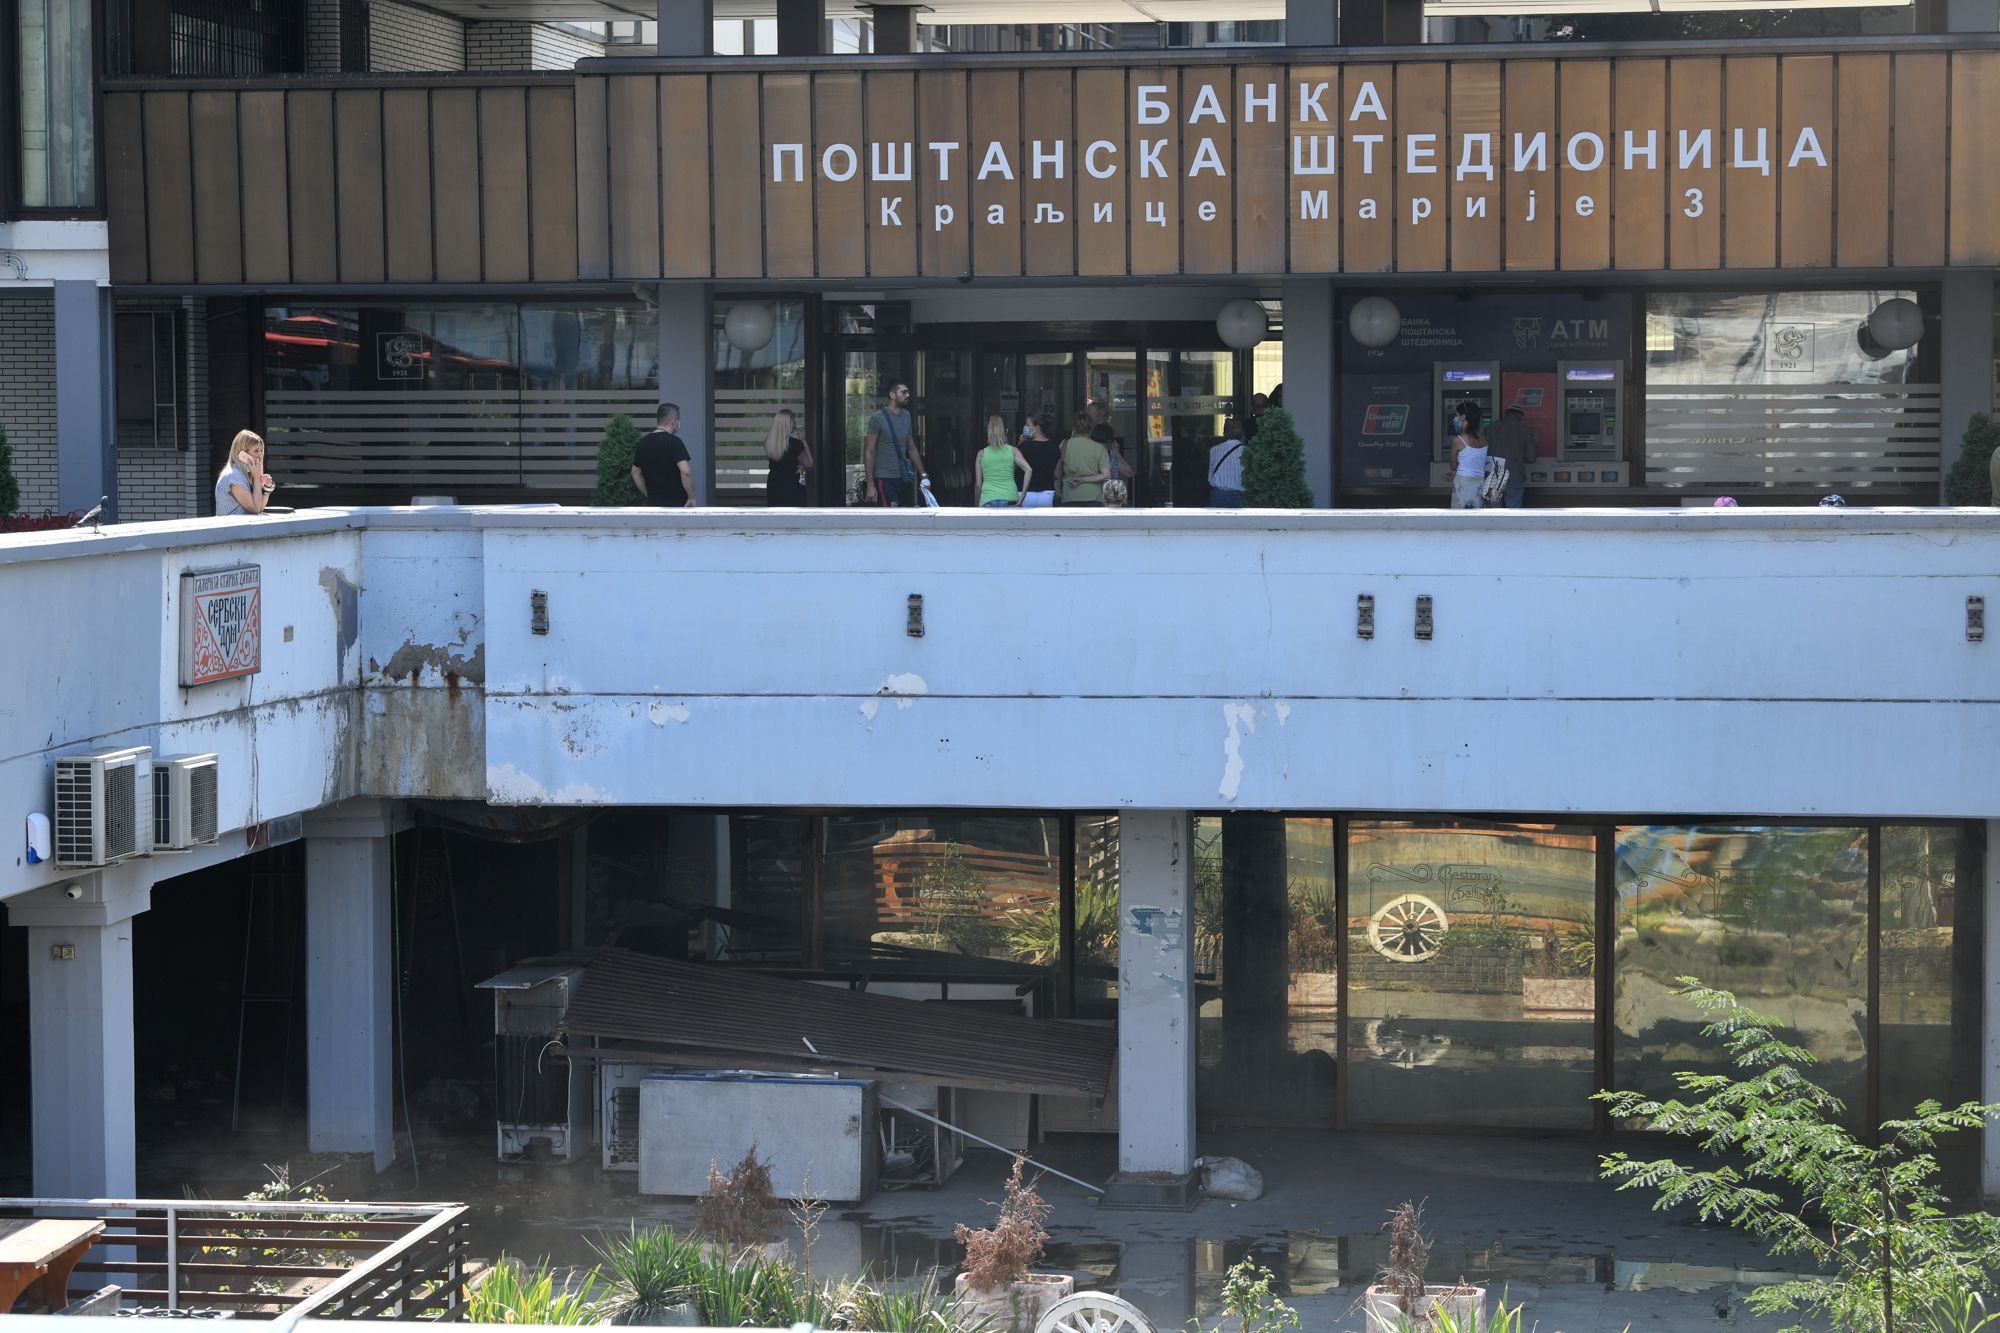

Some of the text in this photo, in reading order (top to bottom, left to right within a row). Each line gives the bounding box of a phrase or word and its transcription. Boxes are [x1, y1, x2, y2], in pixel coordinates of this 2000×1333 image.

[1138, 82, 1387, 124] БАНКА
[773, 127, 1828, 183] ПОШТАНСКА ШТЕДИОНИЦА
[881, 188, 1704, 231] Краљице Марије 3
[1401, 318, 1431, 326] БАНКА
[1401, 328, 1456, 336] ПОШТАНСКА
[1550, 319, 1608, 339] ATM
[1401, 338, 1463, 347] ШТЕДИОНИЦА
[208, 596, 246, 635] СЕРБСКИ
[220, 623, 237, 657] ДОМ
